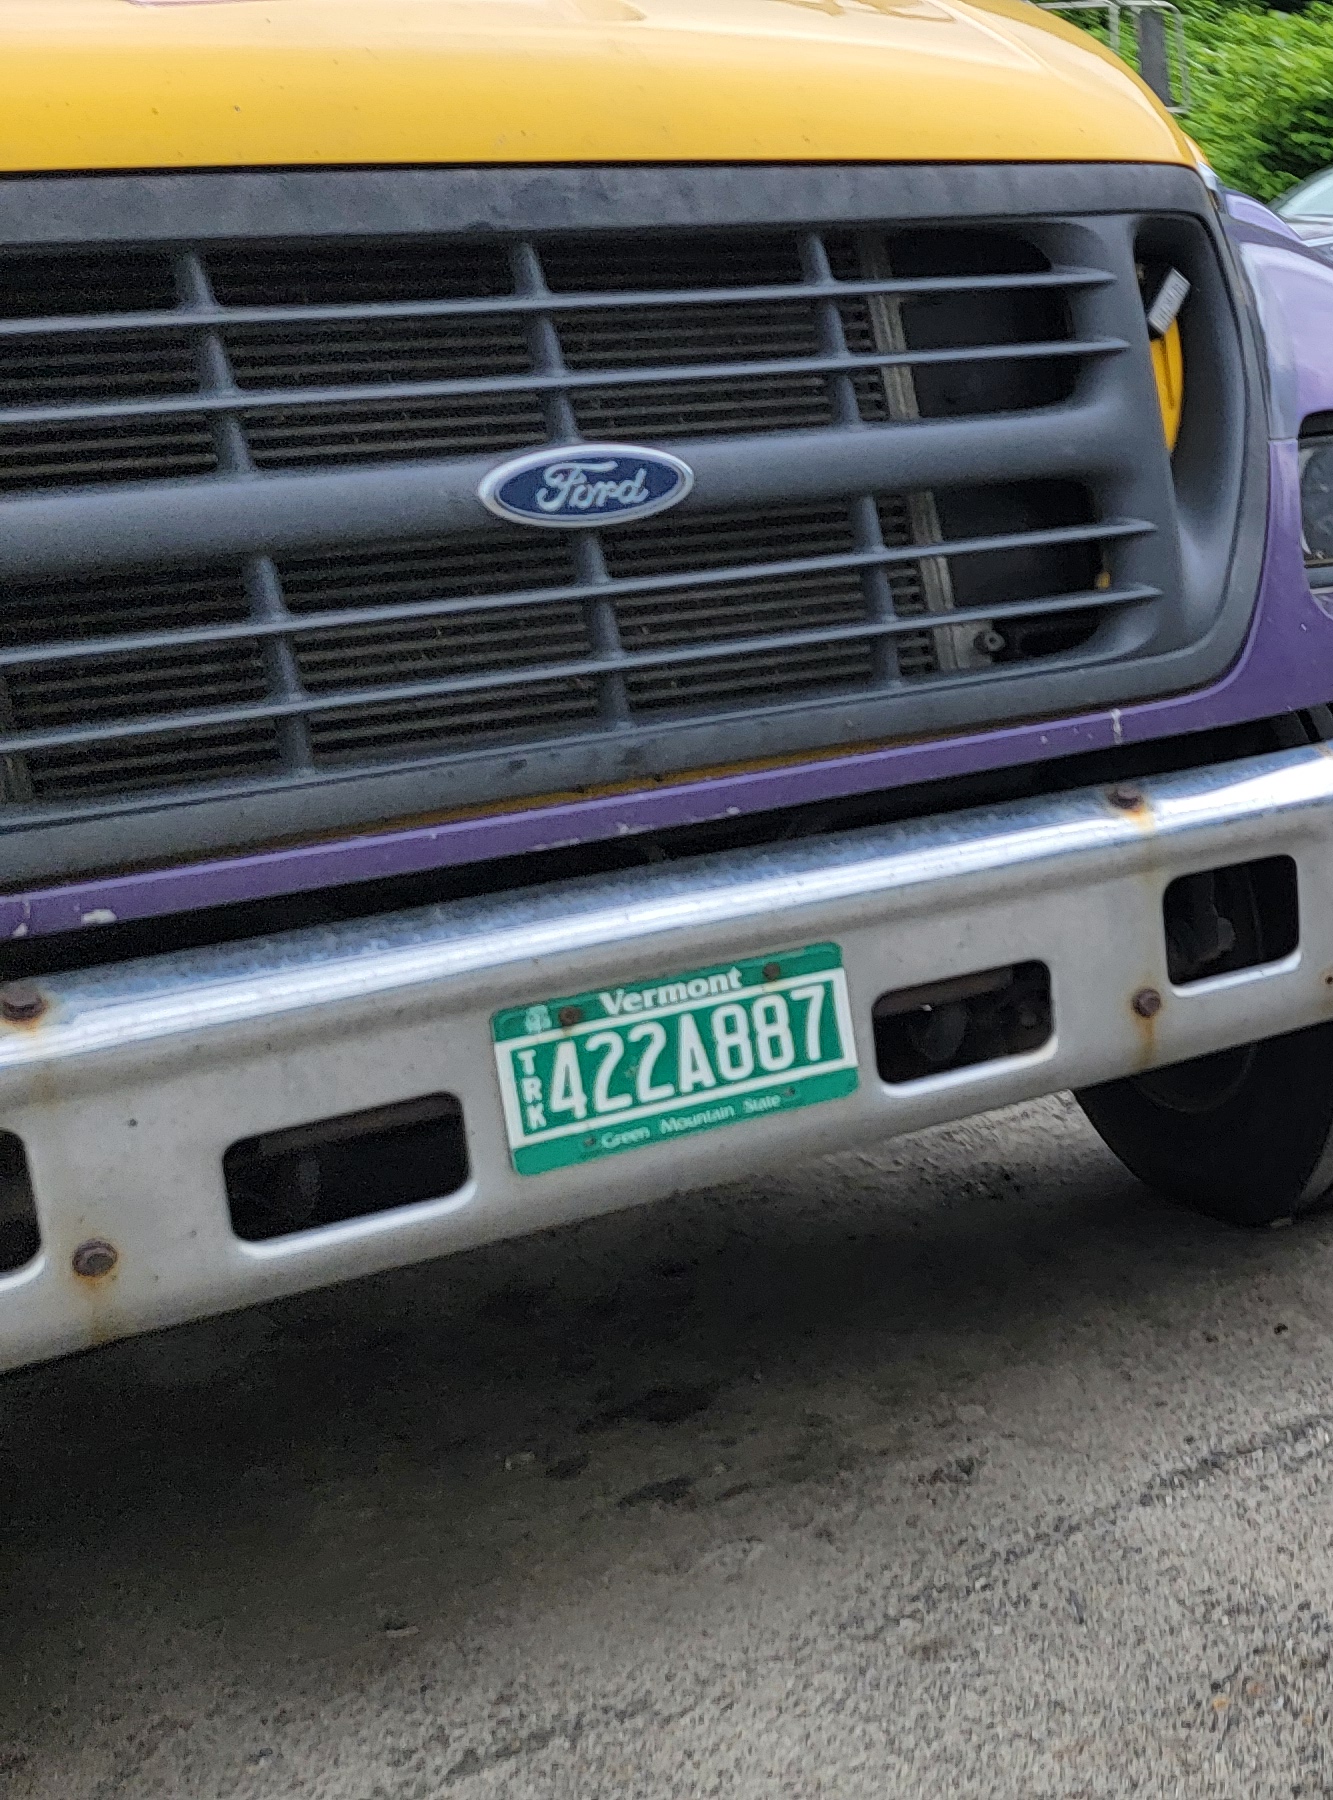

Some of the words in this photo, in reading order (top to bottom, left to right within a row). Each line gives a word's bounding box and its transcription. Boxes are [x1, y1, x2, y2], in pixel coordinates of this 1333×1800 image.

[536, 460, 650, 512] Ford
[599, 965, 743, 1015] Vermont
[549, 984, 826, 1119] 422A887
[517, 1048, 547, 1130] TRK
[601, 1125, 651, 1150] Green
[659, 1103, 736, 1136] Mountain
[742, 1091, 782, 1114] State
